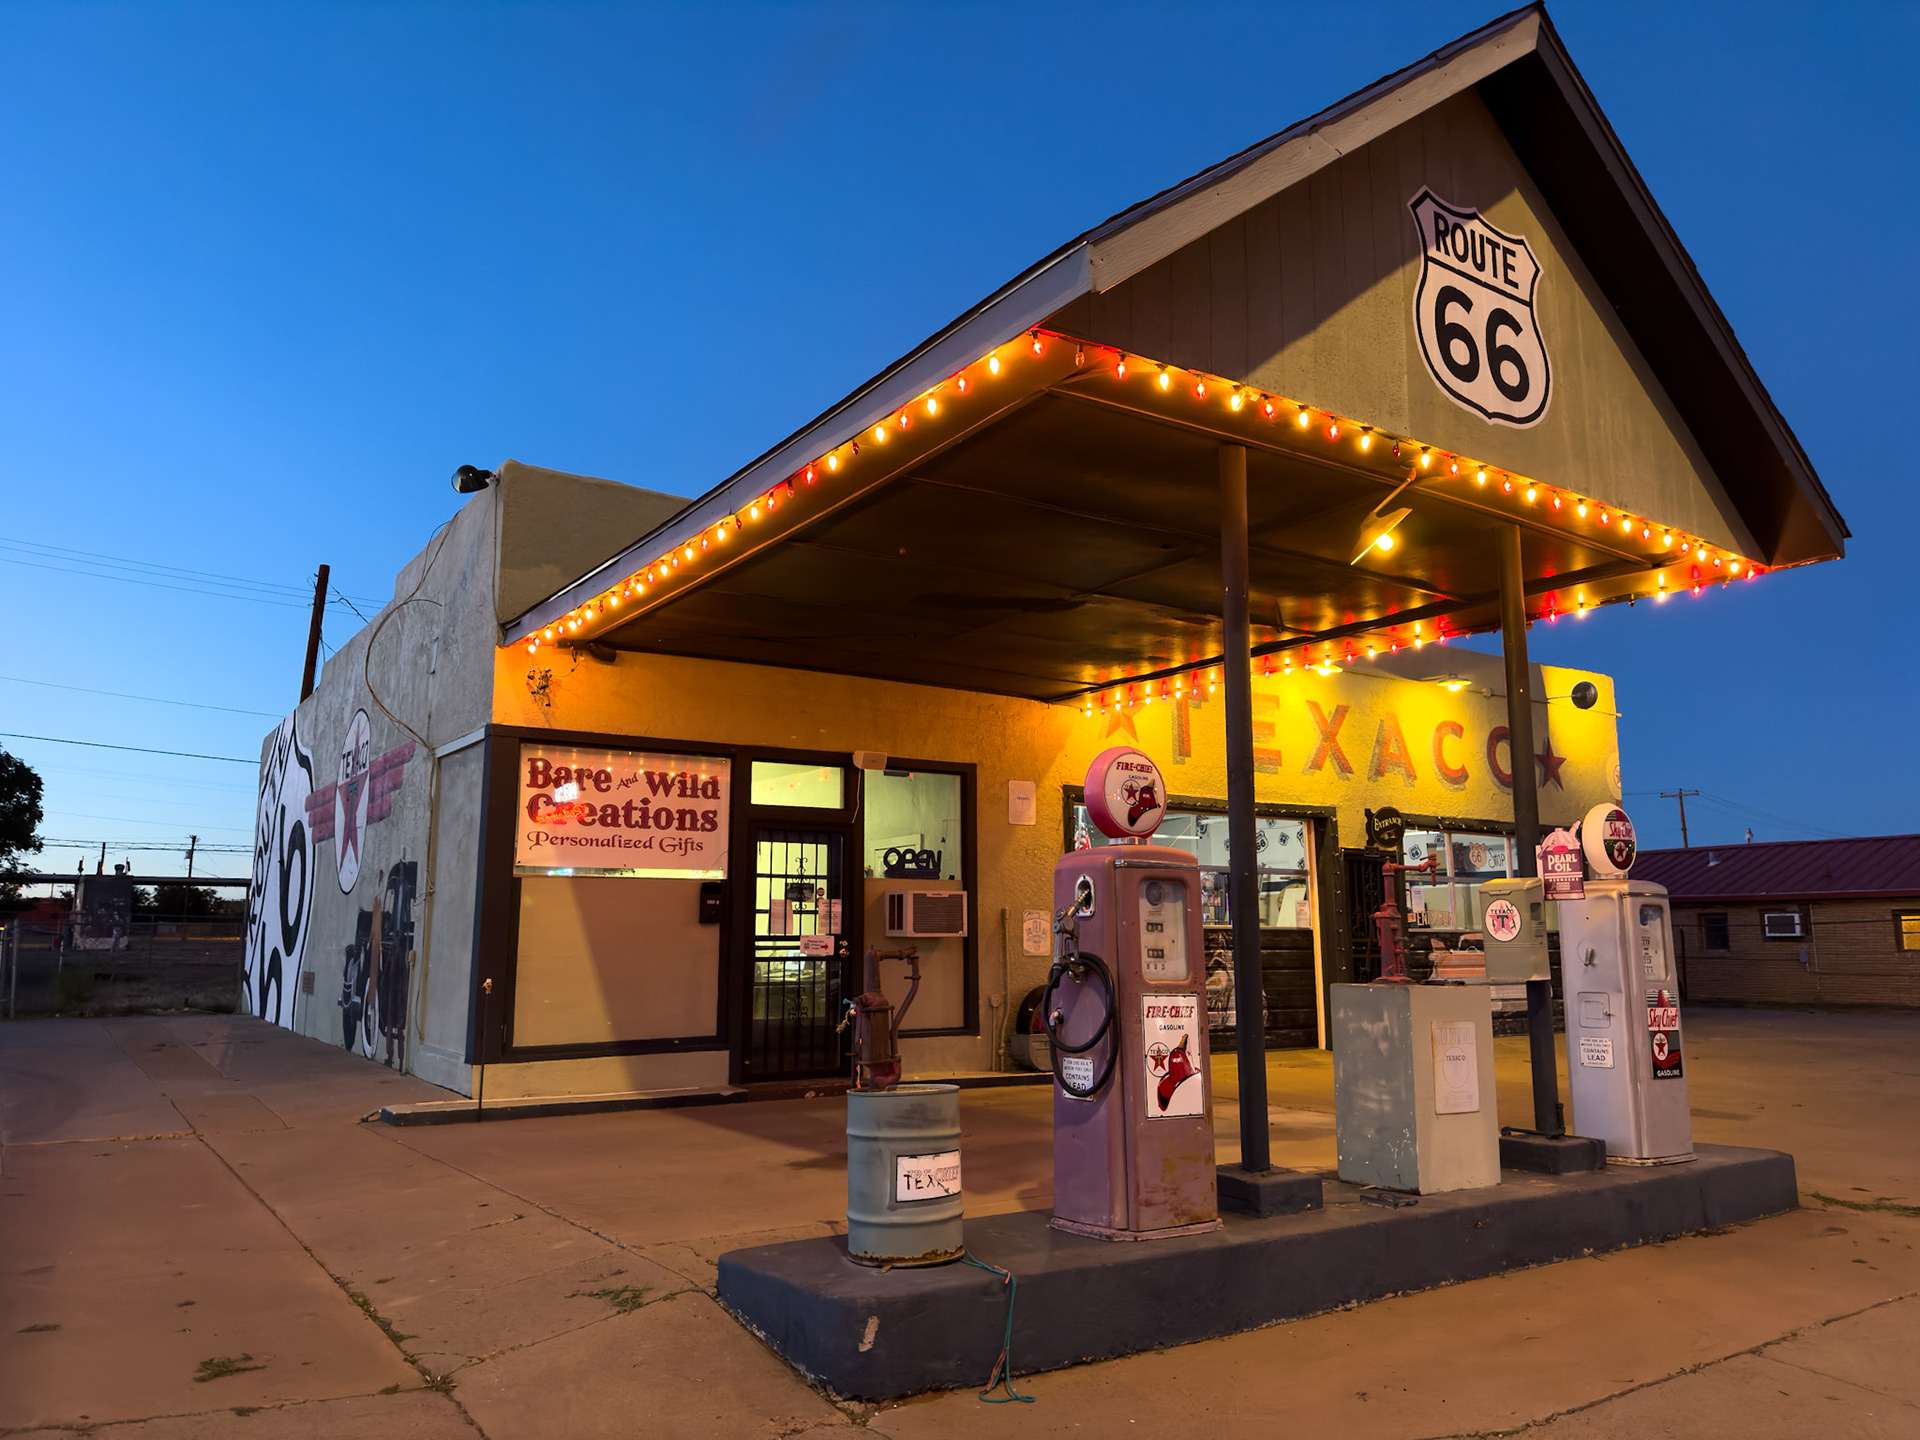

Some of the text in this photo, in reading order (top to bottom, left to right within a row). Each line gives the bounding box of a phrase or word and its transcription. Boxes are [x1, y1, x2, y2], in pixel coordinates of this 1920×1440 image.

[1433, 210, 1520, 290] ROUTE
[1434, 285, 1530, 403] 66
[1168, 688, 1514, 793] TEXACO
[342, 739, 369, 781] TEXACO
[1116, 761, 1153, 774] FIRE-CHIEF
[526, 757, 720, 799] Bare And Wild
[526, 793, 718, 832] Creations
[527, 830, 704, 857] Personalized Gifts
[883, 848, 942, 871] OPEN
[1547, 853, 1578, 871] PEARL
[1554, 862, 1572, 872] OIL
[1146, 1005, 1195, 1019] FIRE-CHIEF
